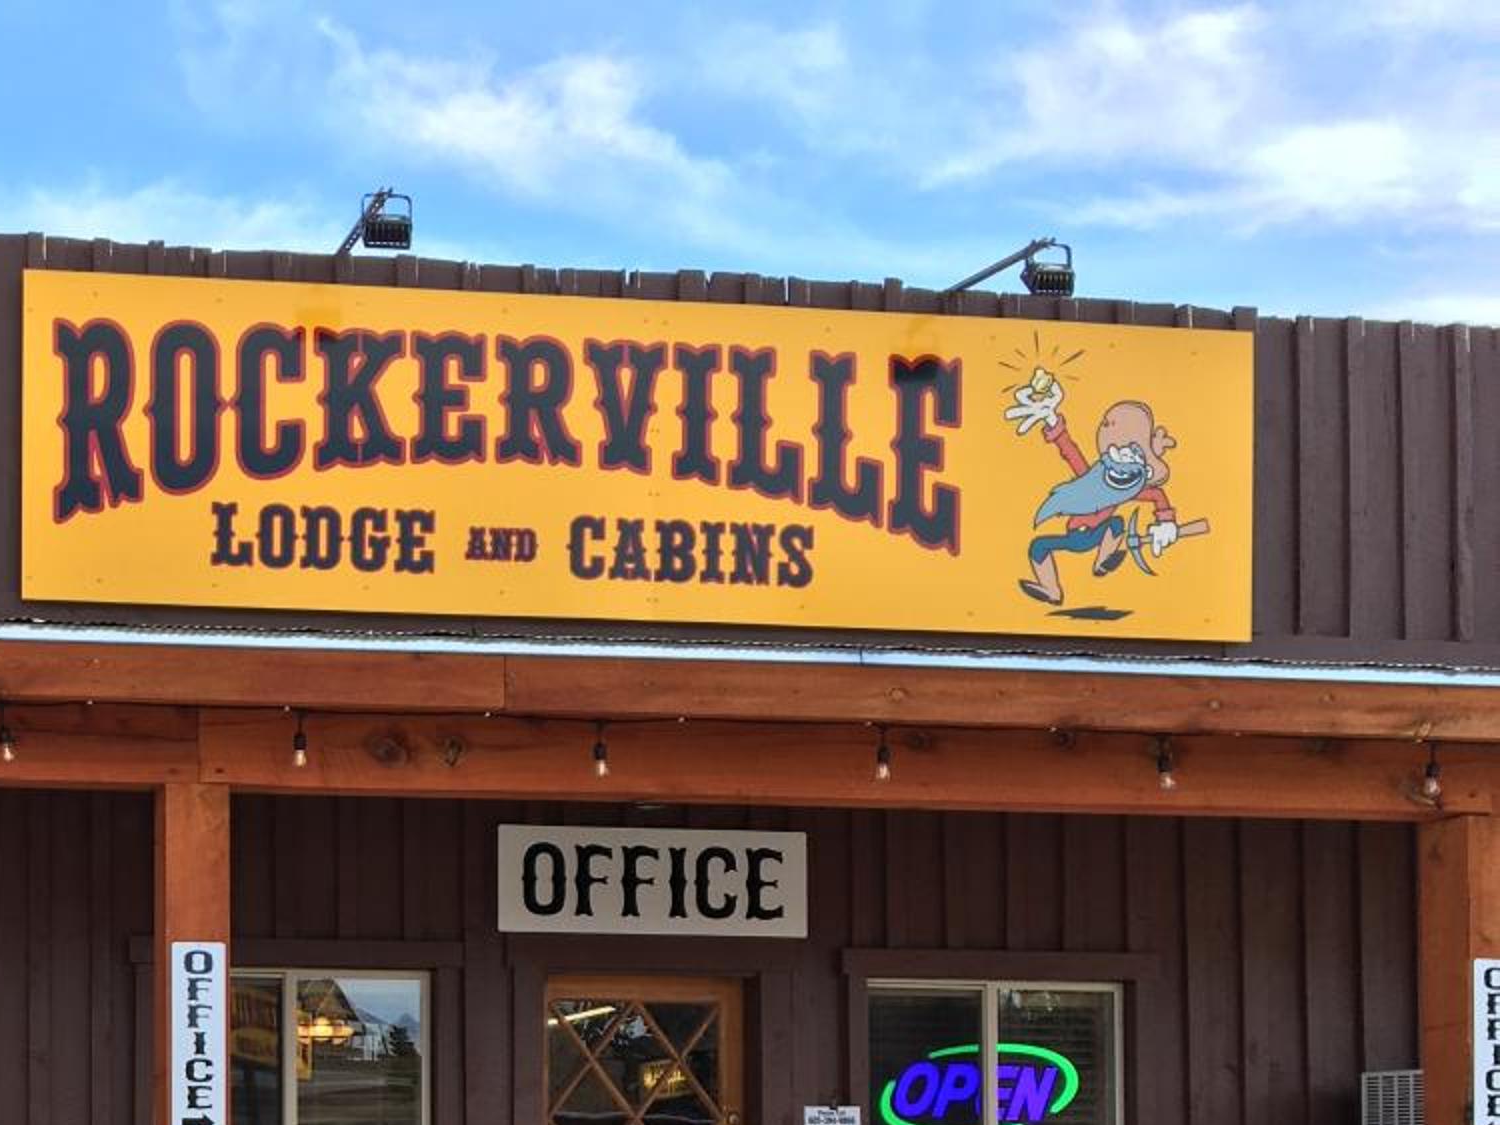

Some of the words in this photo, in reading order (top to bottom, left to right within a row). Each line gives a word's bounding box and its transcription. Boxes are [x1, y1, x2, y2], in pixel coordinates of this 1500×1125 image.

[53, 318, 962, 556] ROCKERVILLE
[210, 501, 436, 574] LODGE
[464, 526, 538, 563] AND
[566, 515, 815, 589] CABINS
[522, 841, 784, 920] OFFICE
[183, 950, 214, 1110] OFFICE
[894, 1061, 1059, 1122] OPEN
